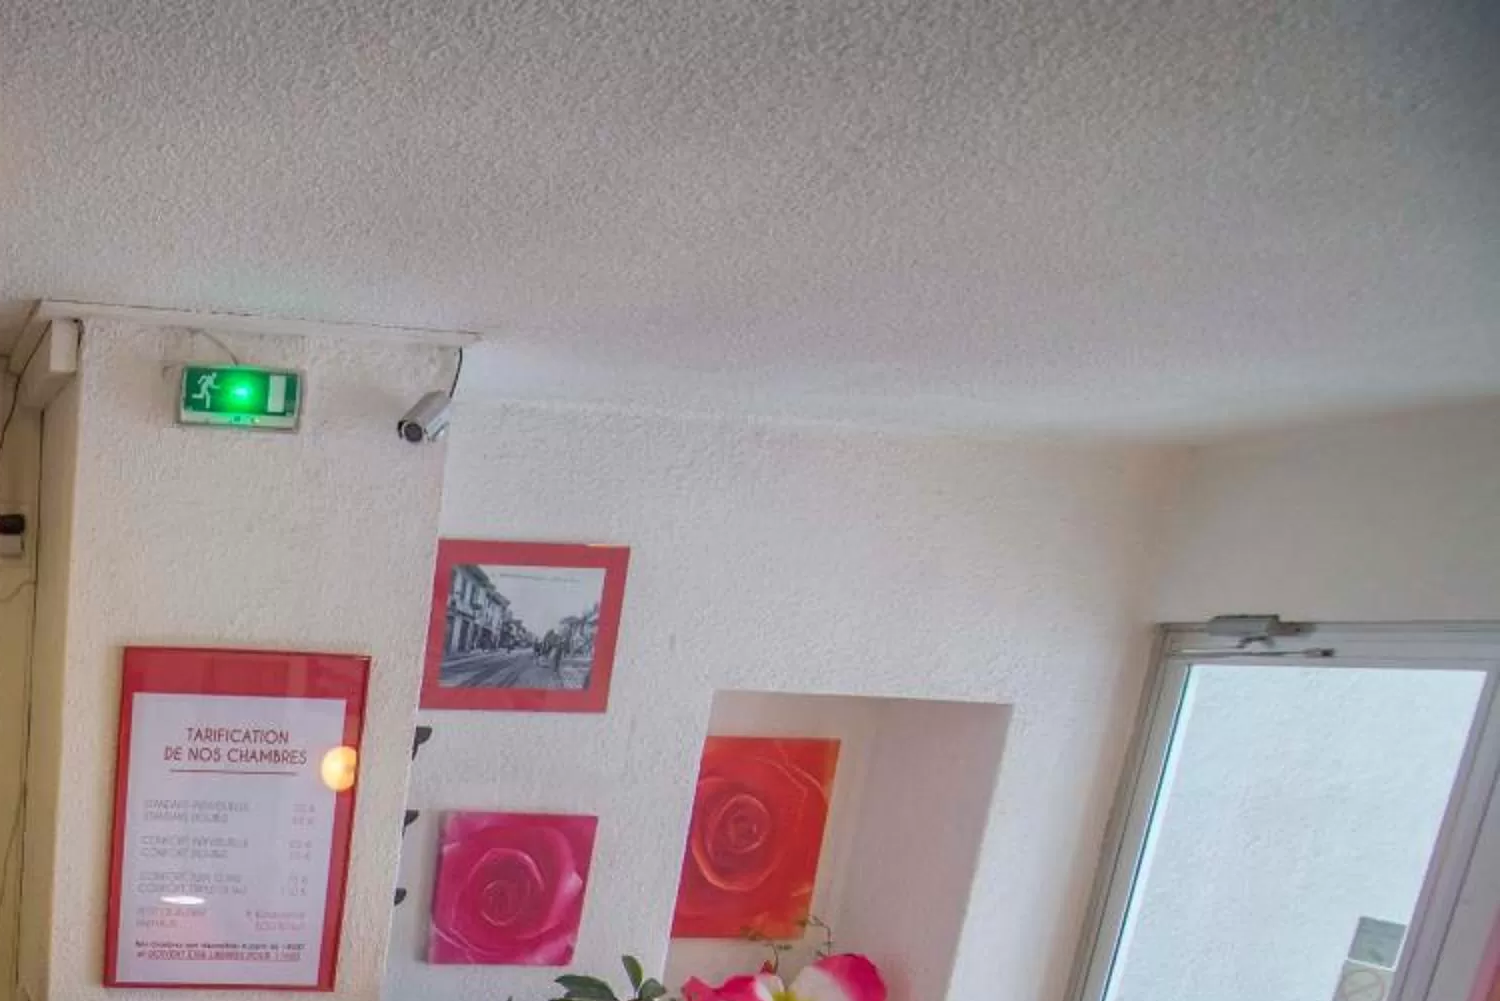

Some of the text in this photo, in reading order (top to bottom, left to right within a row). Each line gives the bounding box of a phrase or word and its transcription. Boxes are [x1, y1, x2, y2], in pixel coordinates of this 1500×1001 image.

[186, 727, 289, 744] TARIFICATION
[164, 746, 308, 765] DE NOS CHAMBRES
